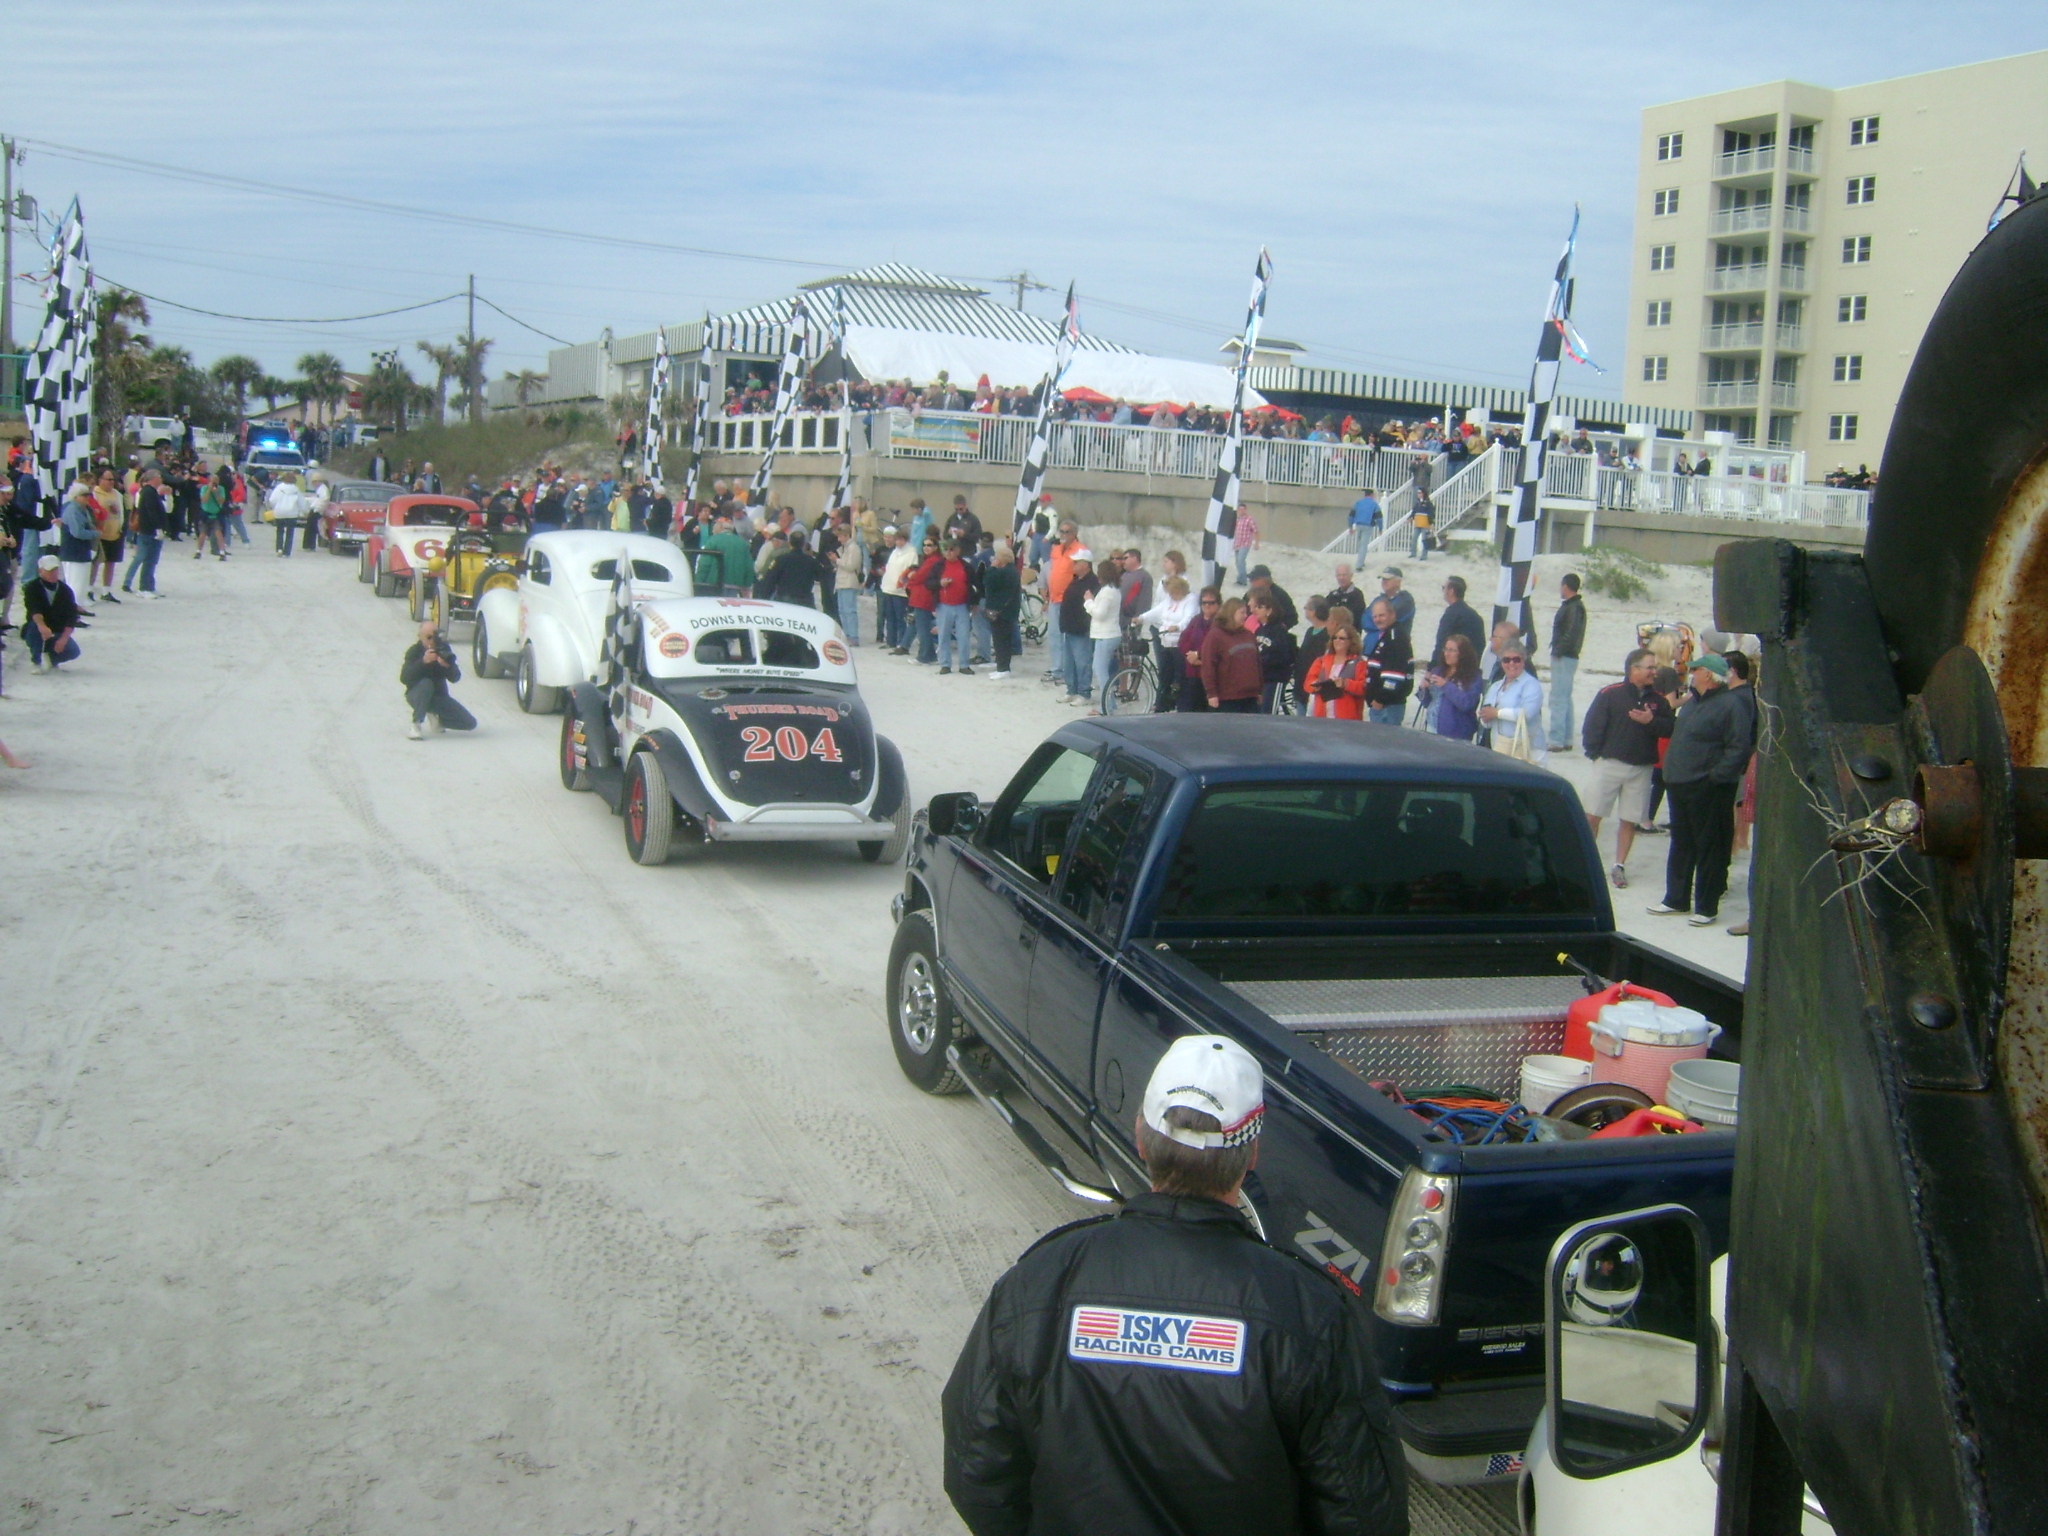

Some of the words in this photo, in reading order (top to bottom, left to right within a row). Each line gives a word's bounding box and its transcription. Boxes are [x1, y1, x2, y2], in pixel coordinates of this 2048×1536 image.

[414, 539, 447, 560] 6
[690, 614, 735, 629] DOWNS
[739, 614, 784, 627] RACING
[787, 618, 817, 635] TEAM
[722, 704, 797, 720] THUNDER
[797, 705, 839, 721] ROAD
[741, 726, 843, 763] 204
[1120, 1314, 1194, 1345] ISKY
[1458, 1322, 1545, 1341] SIERR
[1074, 1336, 1162, 1356] RACING
[1168, 1345, 1235, 1364] CAMS
